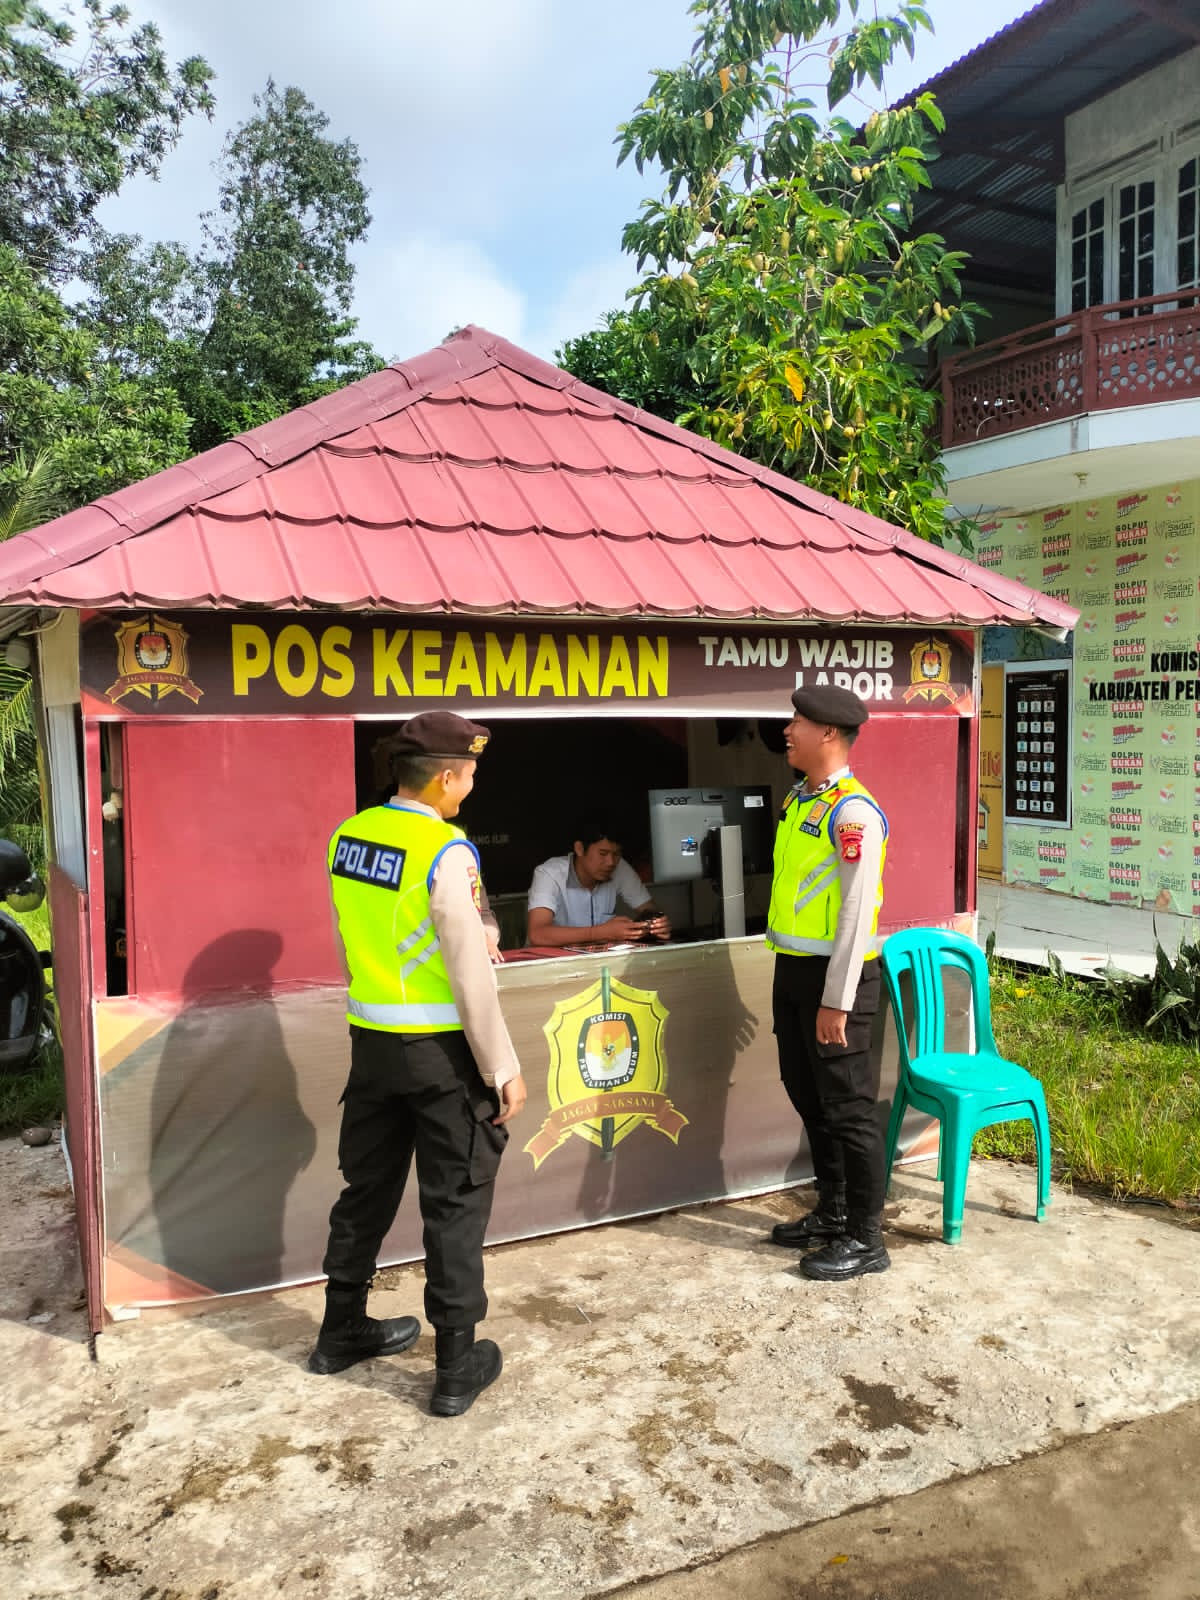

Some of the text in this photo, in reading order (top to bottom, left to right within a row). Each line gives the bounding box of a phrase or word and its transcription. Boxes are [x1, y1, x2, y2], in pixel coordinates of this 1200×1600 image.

[1115, 521, 1147, 531] GOLPUT
[1042, 534, 1070, 543] GOLPUT
[1116, 528, 1147, 540] BUKAN
[1042, 540, 1070, 552] BUKAN
[1116, 538, 1146, 547] SOLUSI
[1115, 580, 1146, 589] GOLPUT
[1041, 588, 1069, 597] OLPUT
[1115, 586, 1146, 599] BUKAN
[1115, 597, 1145, 606] SOLUSI
[1113, 638, 1145, 646] GOLPUT
[699, 637, 789, 667] TAMU
[798, 639, 893, 669] WAJIB
[1114, 645, 1145, 655] BUKAN
[231, 624, 668, 698] POS KEAMANAN
[1089, 680, 1170, 701] KABUPATEN
[1113, 702, 1143, 711] BUKAN
[1112, 711, 1142, 719] SOLUSI
[1111, 759, 1143, 768] BUKAN
[664, 796, 691, 806] acer
[1110, 807, 1142, 815] GOLPUT
[1111, 814, 1141, 824] BUKAN
[1110, 823, 1140, 831] SOLUSI
[334, 840, 402, 884] POLISI
[1109, 861, 1141, 871] GOLPUT
[1110, 869, 1141, 879] BUKAN
[1110, 878, 1140, 887] SOLUSI
[590, 1013, 626, 1024] KOMISI
[579, 1051, 638, 1087] PEMILIHAN UMUM
[562, 1104, 598, 1121] JAGAT
